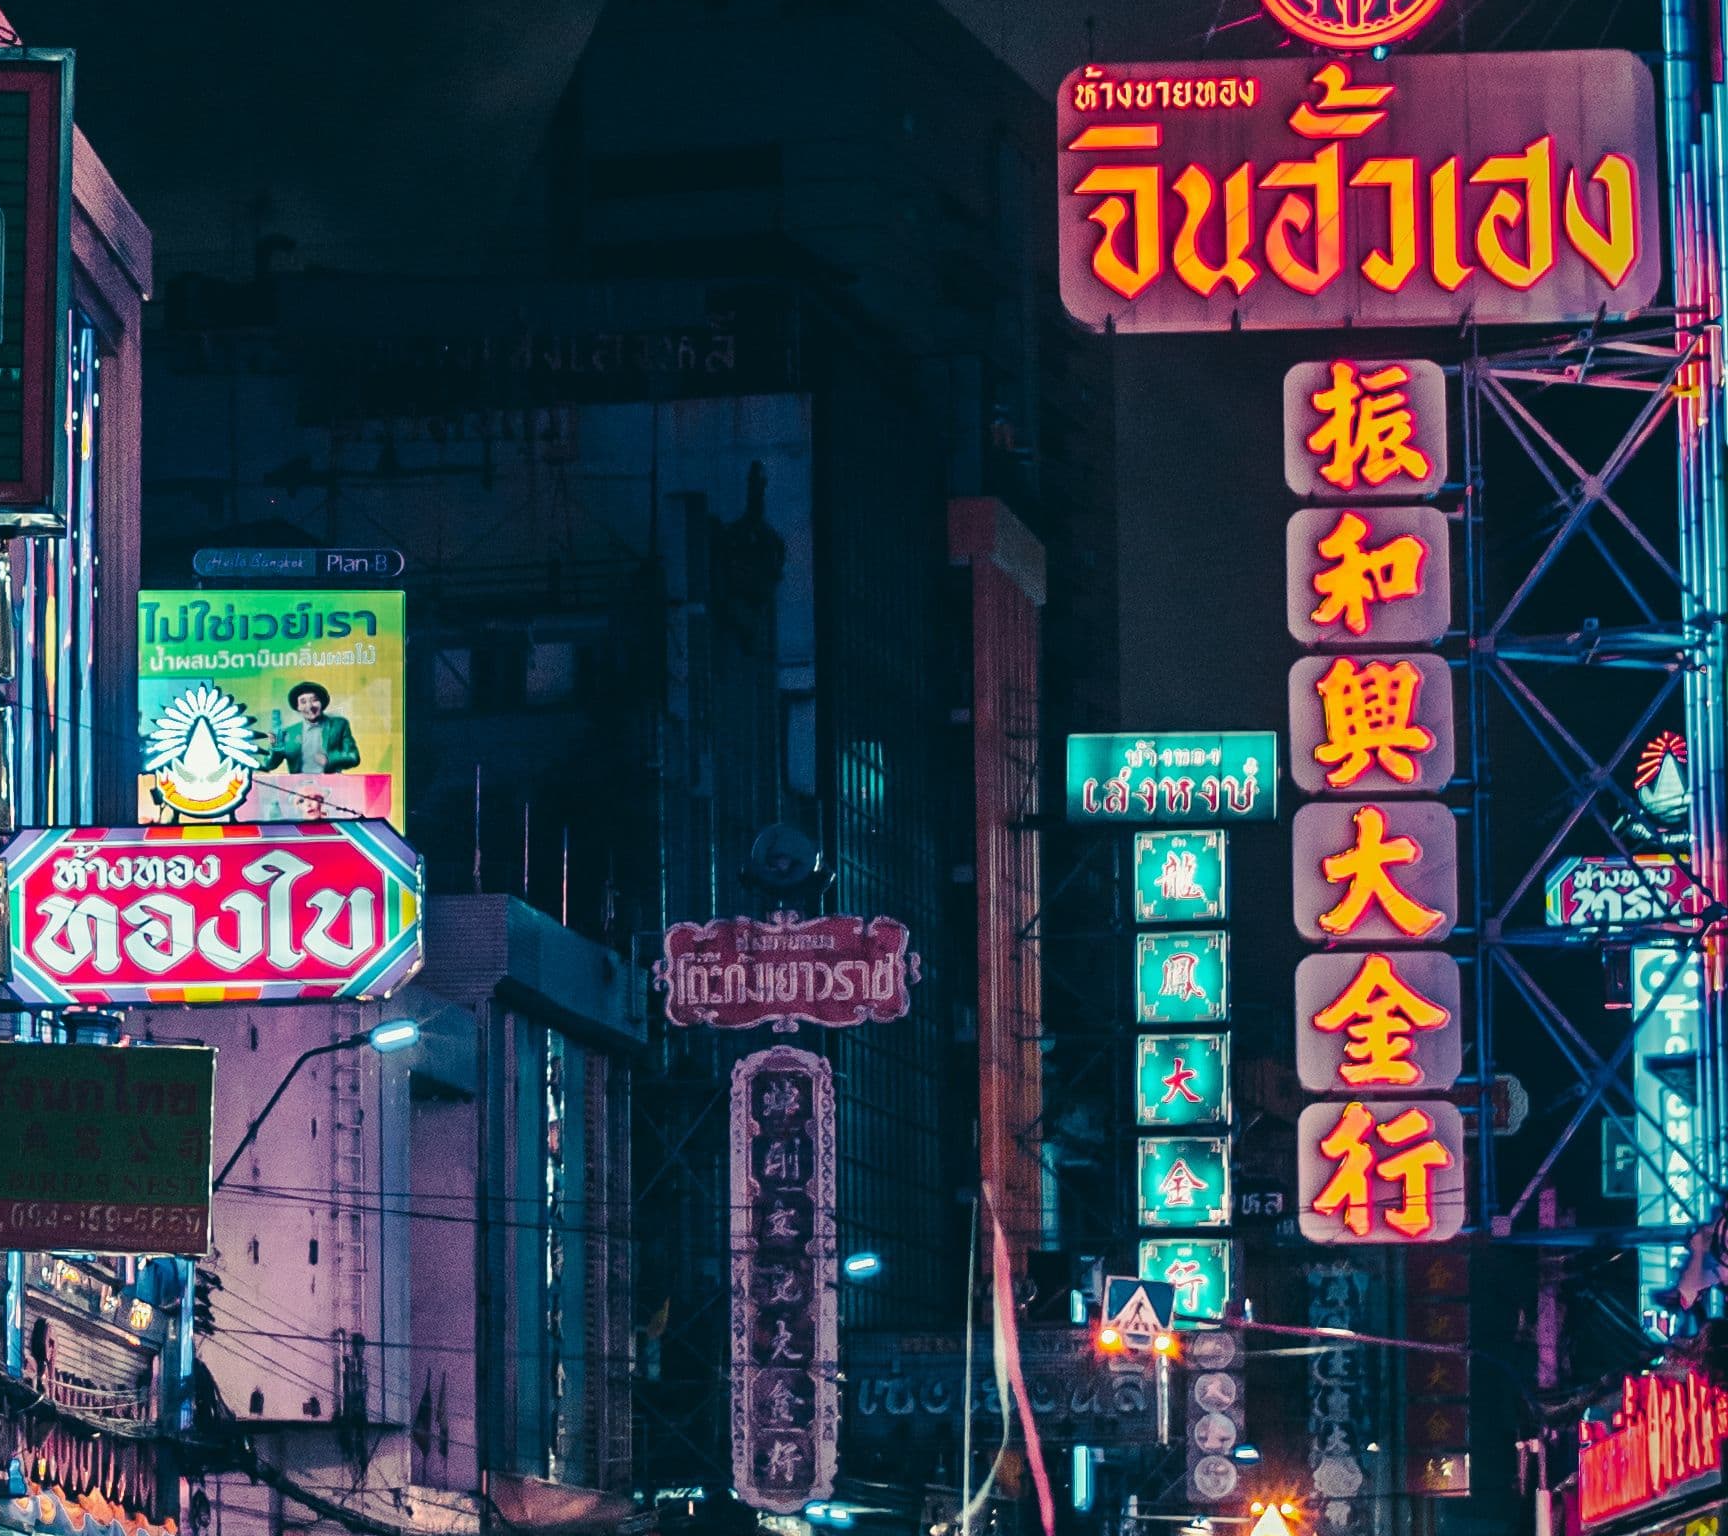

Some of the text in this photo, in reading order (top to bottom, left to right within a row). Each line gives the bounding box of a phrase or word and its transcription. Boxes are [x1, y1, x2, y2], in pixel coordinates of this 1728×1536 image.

[1073, 66, 1261, 112] ห้างขายทอง
[1068, 62, 1642, 301] จินฮั้วเฮง
[327, 554, 369, 572] Plan
[51, 846, 221, 890] ห้างทอง
[31, 848, 377, 975] ทองใบ
